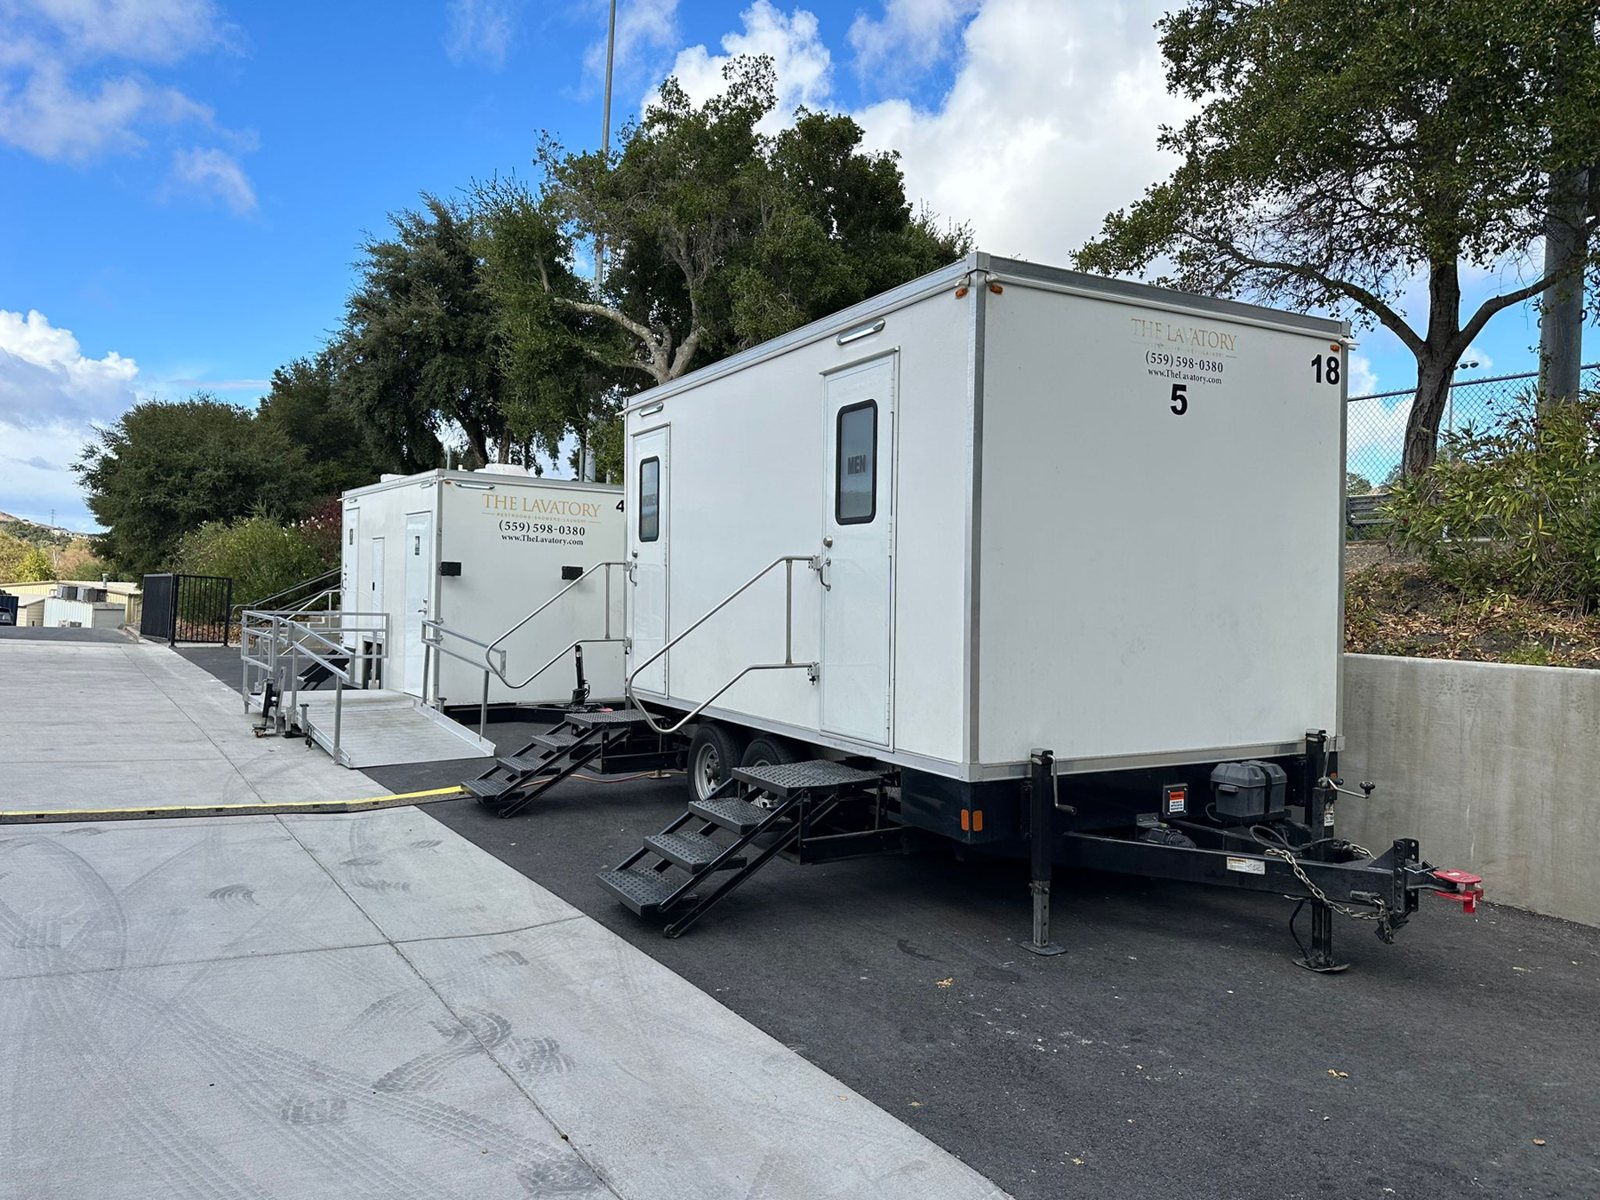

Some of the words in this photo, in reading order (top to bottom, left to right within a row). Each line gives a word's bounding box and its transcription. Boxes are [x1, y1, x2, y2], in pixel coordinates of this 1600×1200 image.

[1145, 350, 1174, 367] (559)
[1176, 355, 1224, 373] 598-0380
[1311, 354, 1340, 385] 18
[1148, 368, 1222, 384] www.TheLavatory.com
[1170, 383, 1188, 416] 5
[847, 455, 866, 475] MEN
[482, 493, 517, 510] THE
[523, 497, 601, 518] LAVATORY
[616, 499, 625, 513] 4
[499, 519, 530, 533] (559)
[532, 523, 586, 537] 598-0380
[501, 534, 584, 547] www.TheLavatory.com
